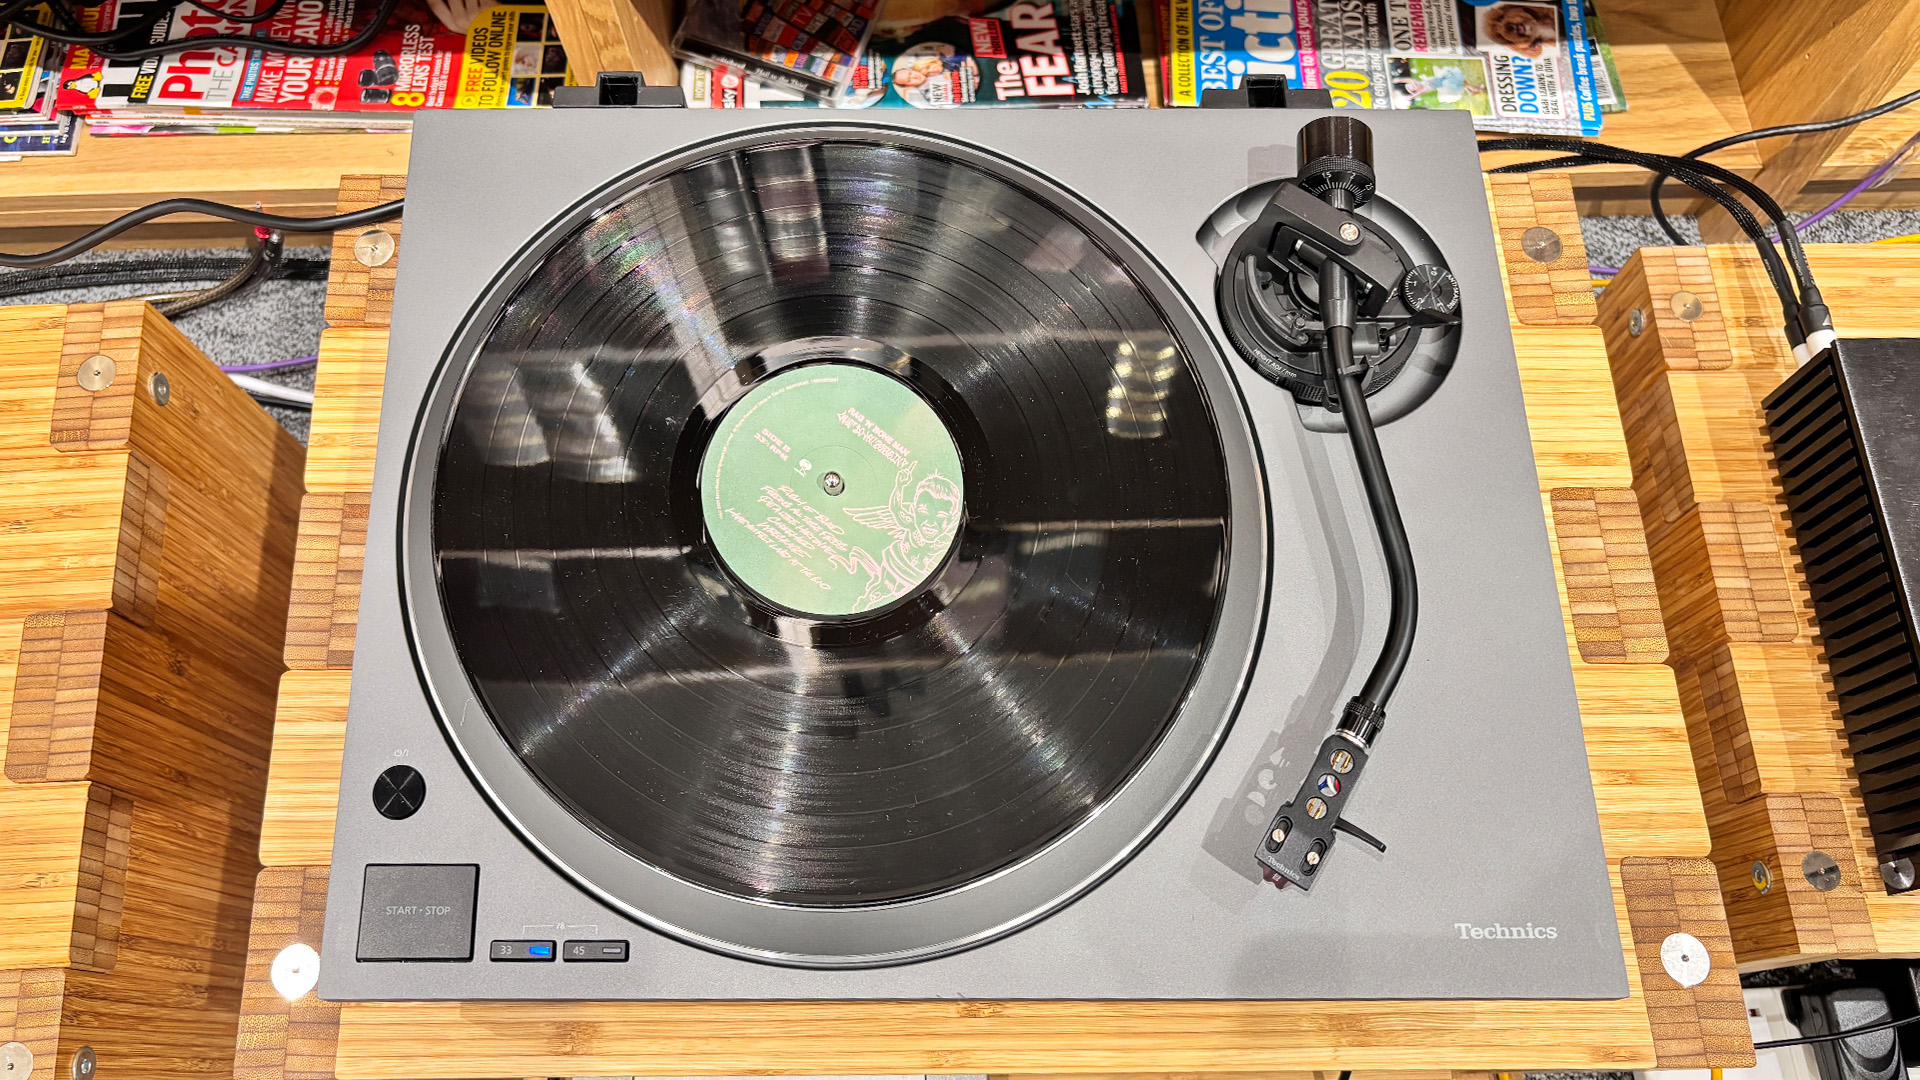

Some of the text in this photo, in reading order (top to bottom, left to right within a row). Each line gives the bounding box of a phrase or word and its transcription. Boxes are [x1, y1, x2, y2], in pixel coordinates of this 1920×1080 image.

[1175, 6, 1189, 22] THE
[1569, 8, 1579, 22] two
[488, 11, 508, 48] ONLINE
[971, 22, 992, 53] NEW
[986, 21, 1003, 55] THRILLER
[1176, 24, 1189, 36] OF
[1339, 0, 1369, 71] READS
[1390, 16, 1412, 51] ONE
[1569, 22, 1586, 53] puzzles,
[1010, 3, 1076, 97] FEAR
[1070, 32, 1087, 72] Hartnett
[1198, 0, 1228, 89] BEST OF
[1296, 30, 1311, 54] treat
[69, 45, 90, 70] MA
[139, 56, 160, 76] VID
[391, 24, 426, 107] 8 MIRRORLESS
[412, 36, 435, 92] LENS TEST
[465, 27, 489, 92] FREE VIDEOS
[1085, 22, 1105, 88] money-making
[1176, 38, 1190, 88] COLLECTION
[1300, 55, 1313, 66] to
[1317, 0, 1373, 109] 20 GREAT
[1363, 3, 1387, 109] To enjoy and relax with
[1543, 58, 1553, 72] DIVA
[1573, 53, 1588, 75] break
[244, 61, 260, 85] PHOTOS
[482, 51, 502, 92] FOLLOW
[1535, 63, 1544, 72] TO
[130, 75, 154, 99] FREE
[205, 70, 234, 100] THE
[254, 70, 283, 103] MAKE
[277, 57, 315, 103] YOUR
[695, 81, 704, 98] HOW
[993, 61, 1025, 101] The
[1074, 73, 1091, 95] Josh
[1494, 55, 1517, 113] DRESSING
[1512, 56, 1539, 114] DOWN?
[1536, 74, 1548, 97] LEARNS
[1547, 80, 1557, 97] WITH
[1577, 77, 1593, 101] Coffee
[478, 94, 494, 106] TO
[721, 88, 737, 109] sky
[931, 83, 942, 102] NEW
[1550, 99, 1560, 115] DEAL
[1581, 102, 1596, 121] PLUS
[1350, 172, 1357, 180] 2
[760, 427, 783, 447] SIDE
[848, 406, 866, 423] RAG
[872, 425, 895, 445] BONE
[891, 440, 911, 457] MAN
[769, 444, 790, 461] RPM
[1266, 854, 1300, 881] Technics
[386, 905, 451, 916] START STOP
[1454, 922, 1558, 940] Technics
[500, 945, 513, 955] 33
[573, 946, 585, 956] 45
